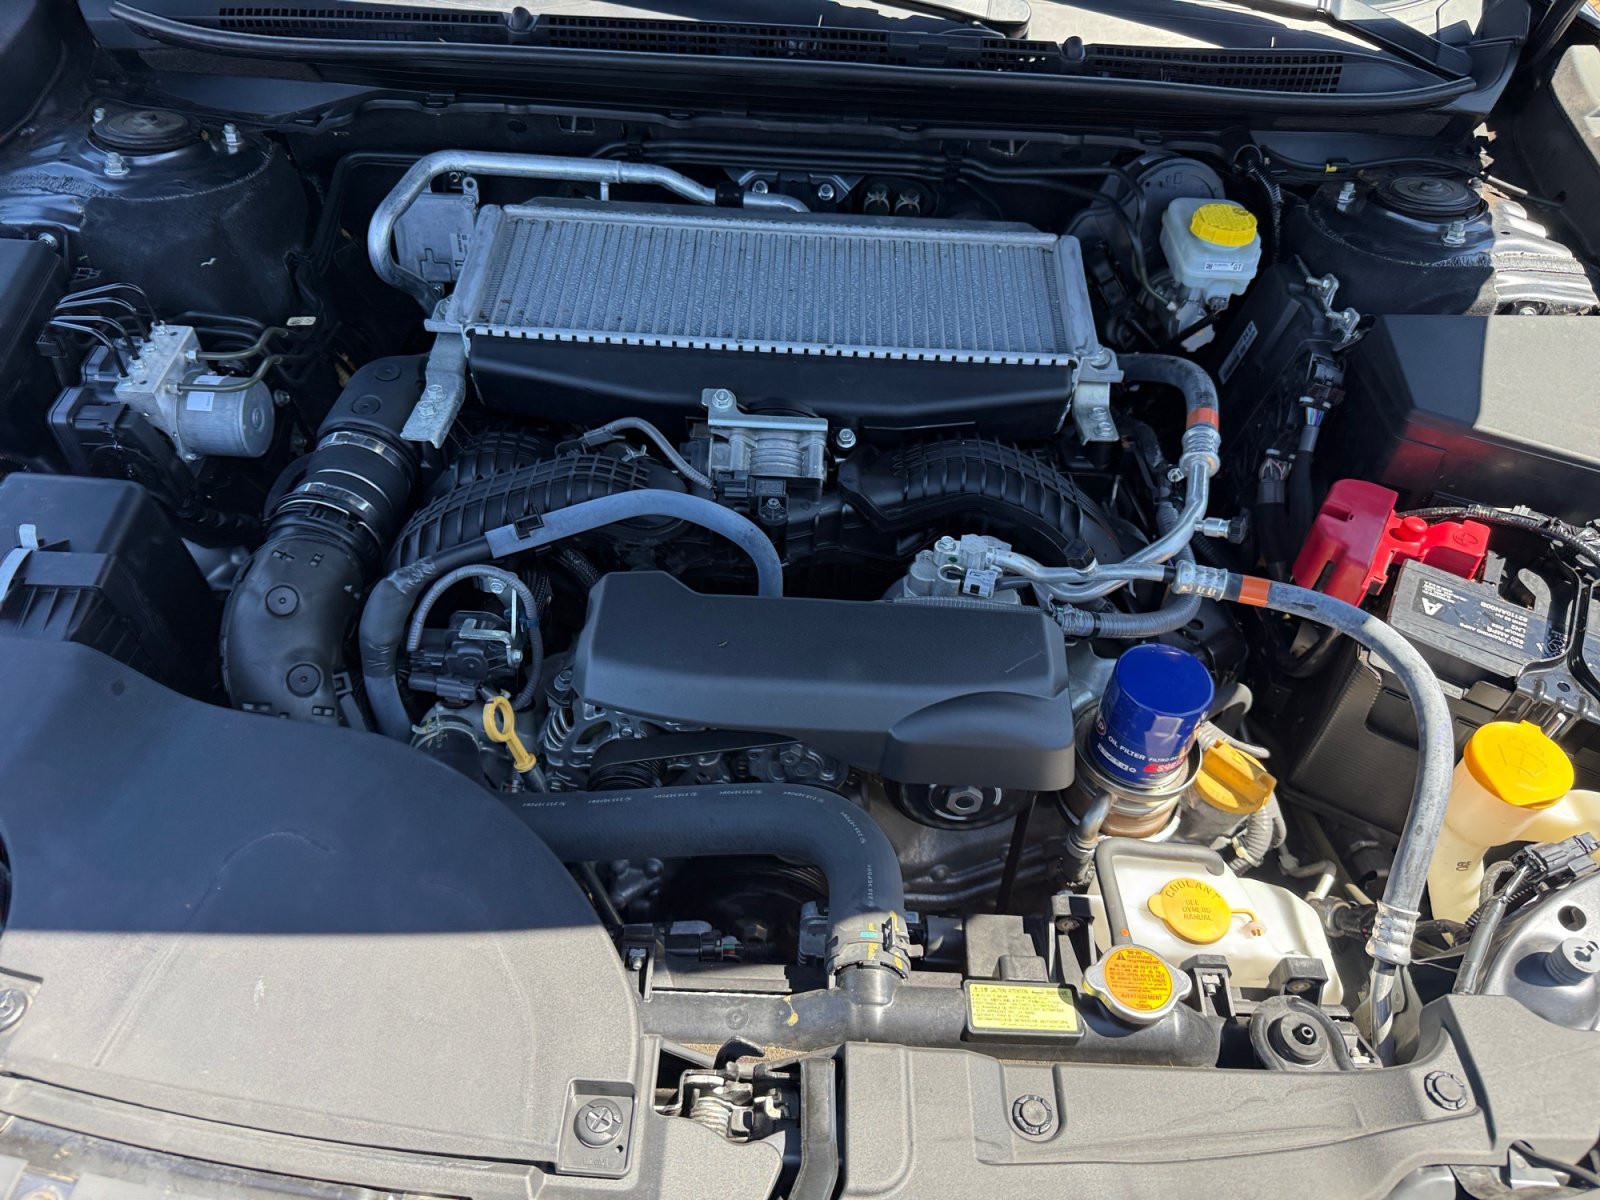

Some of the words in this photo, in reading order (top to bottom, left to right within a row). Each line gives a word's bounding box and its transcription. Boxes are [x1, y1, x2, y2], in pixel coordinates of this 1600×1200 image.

[1108, 735, 1119, 748] OIL
[1119, 745, 1147, 761] FILTER
[1165, 880, 1221, 898] COOLANT
[1183, 913, 1214, 921] MANUAL
